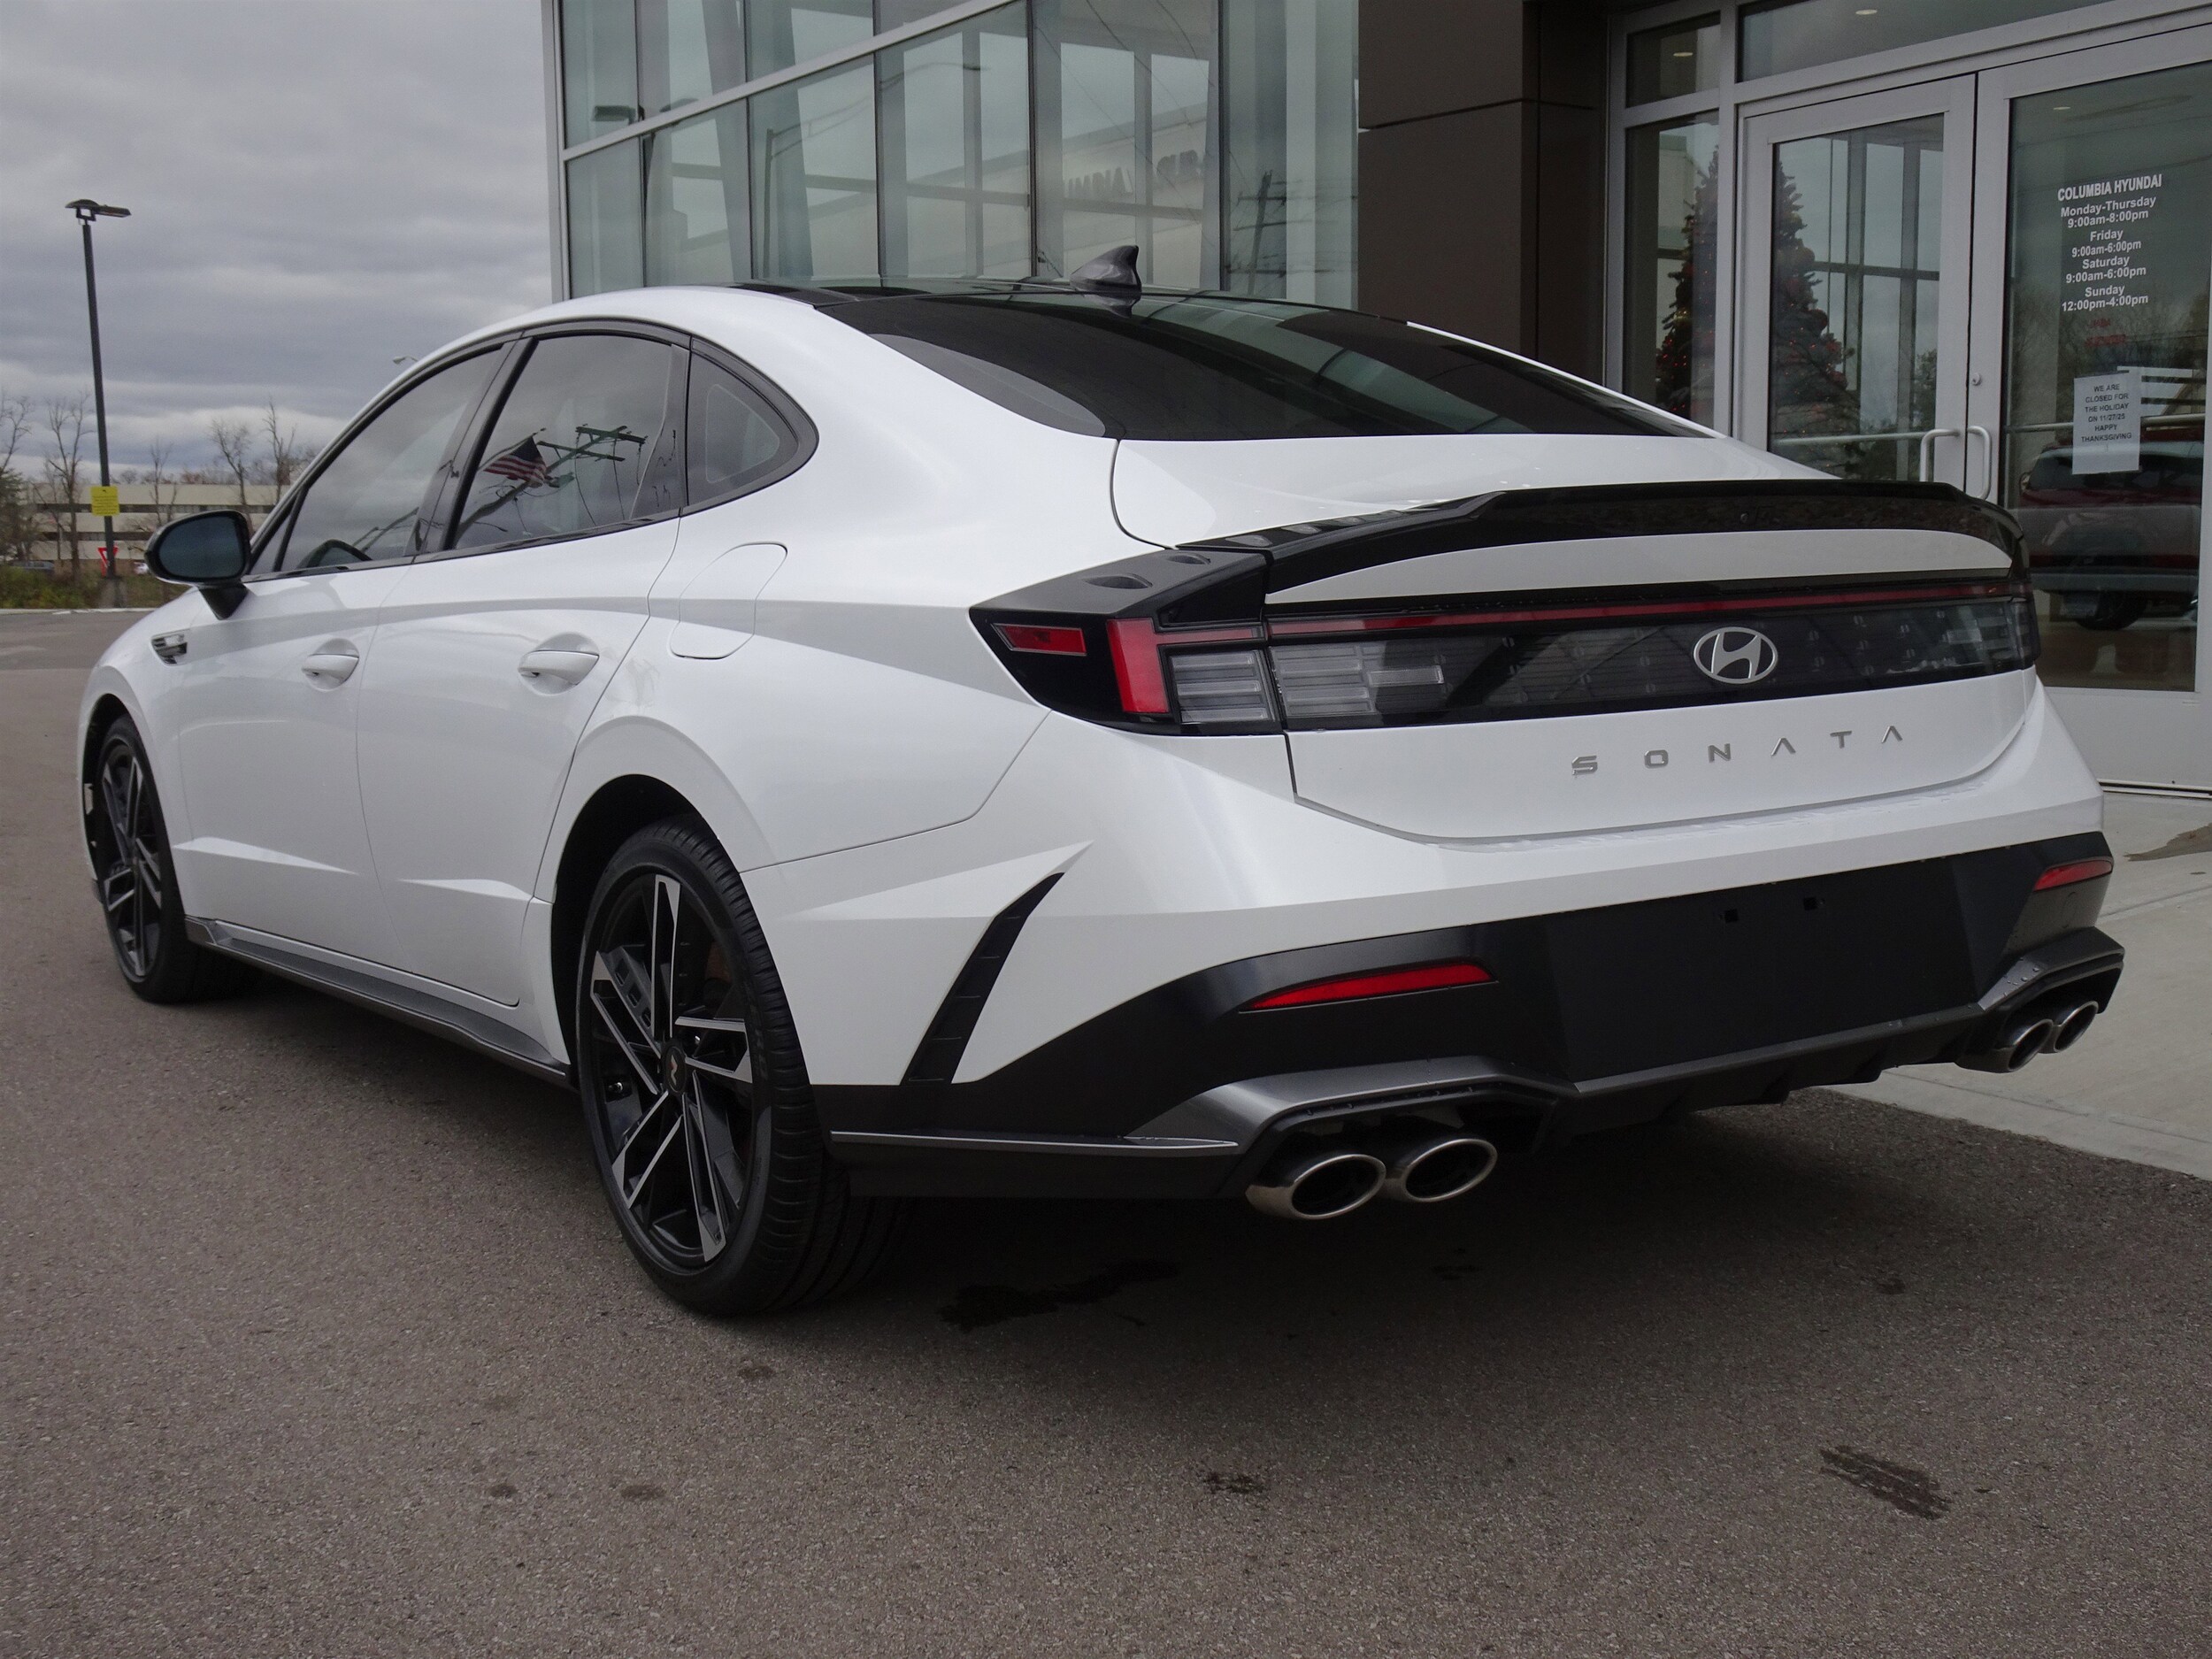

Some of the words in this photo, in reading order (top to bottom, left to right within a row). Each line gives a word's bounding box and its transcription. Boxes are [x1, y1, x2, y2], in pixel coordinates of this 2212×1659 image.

[2057, 181, 2112, 202] COLUMBIA
[2114, 173, 2162, 194] HYUNDAI
[2060, 196, 2157, 218] Monday-Thursday
[2067, 210, 2149, 228] 9:00am-8:00pm
[2090, 228, 2124, 242] Friday
[2071, 240, 2142, 257] 9:00am-6:00pm
[2082, 256, 2131, 270] Saturday
[2065, 266, 2147, 283] 9:00am-6:00pm
[2085, 285, 2125, 297] Sunday
[2062, 295, 2149, 312] 12:00pm-4:00pm
[2085, 394, 2113, 403] CLOSED
[2100, 403, 2130, 411] HOLIDAY
[2081, 432, 2132, 442] THANKSGIVING
[1571, 725, 1903, 776] SONATA
